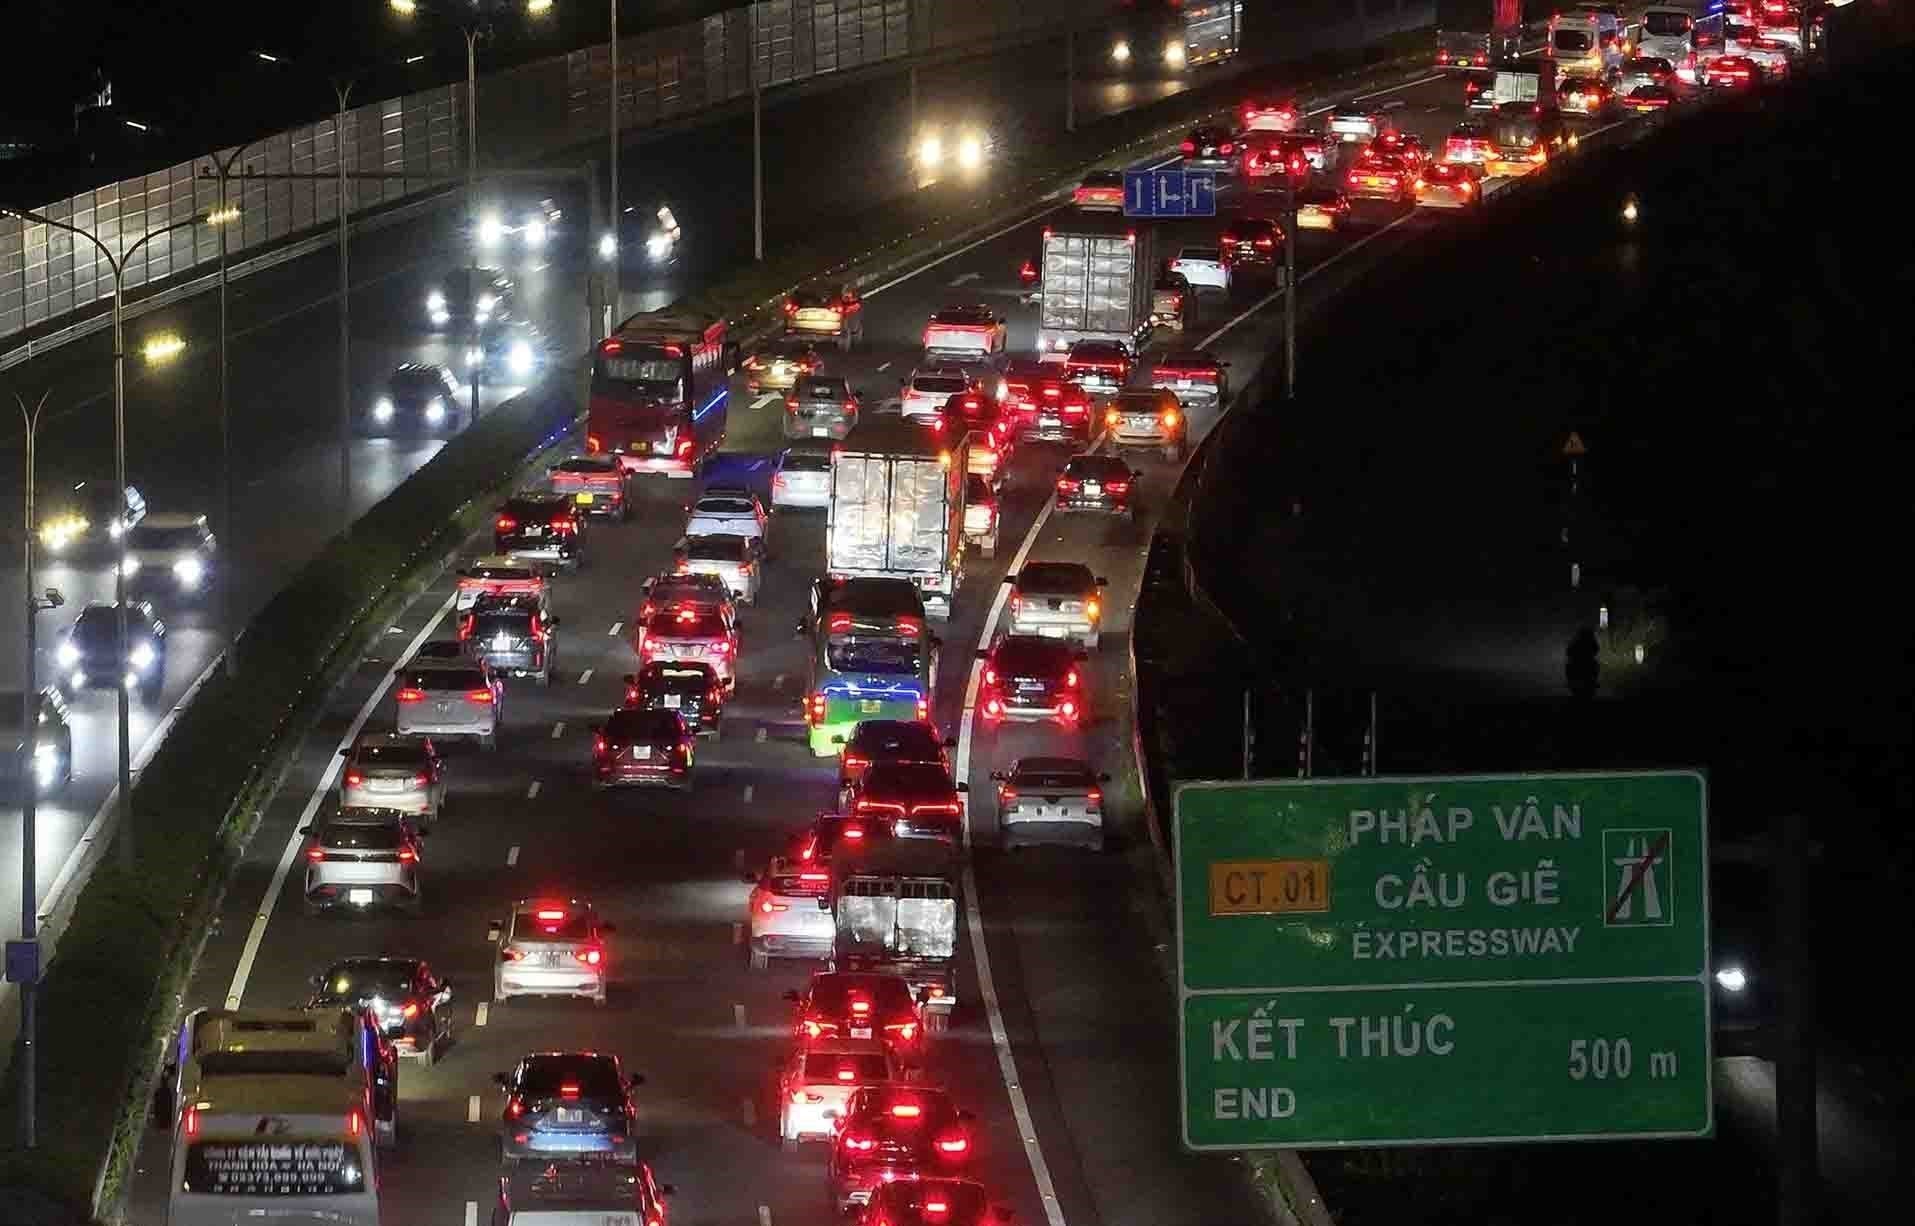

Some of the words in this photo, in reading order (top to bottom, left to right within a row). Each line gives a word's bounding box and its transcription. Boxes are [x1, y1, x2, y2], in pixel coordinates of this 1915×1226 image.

[1349, 795, 1474, 844] PHÁP
[1493, 796, 1584, 841] VÂN
[1223, 869, 1317, 906] CT.01
[1375, 857, 1467, 909] CẦU
[1487, 860, 1562, 906] GIẼ
[1352, 927, 1580, 960] EXPRESSWAY
[1213, 1000, 1305, 1061] KẾT
[1329, 1004, 1456, 1057] THÚC
[1568, 1038, 1632, 1080] 500
[1649, 1050, 1677, 1078] m
[1214, 1087, 1297, 1119] END
